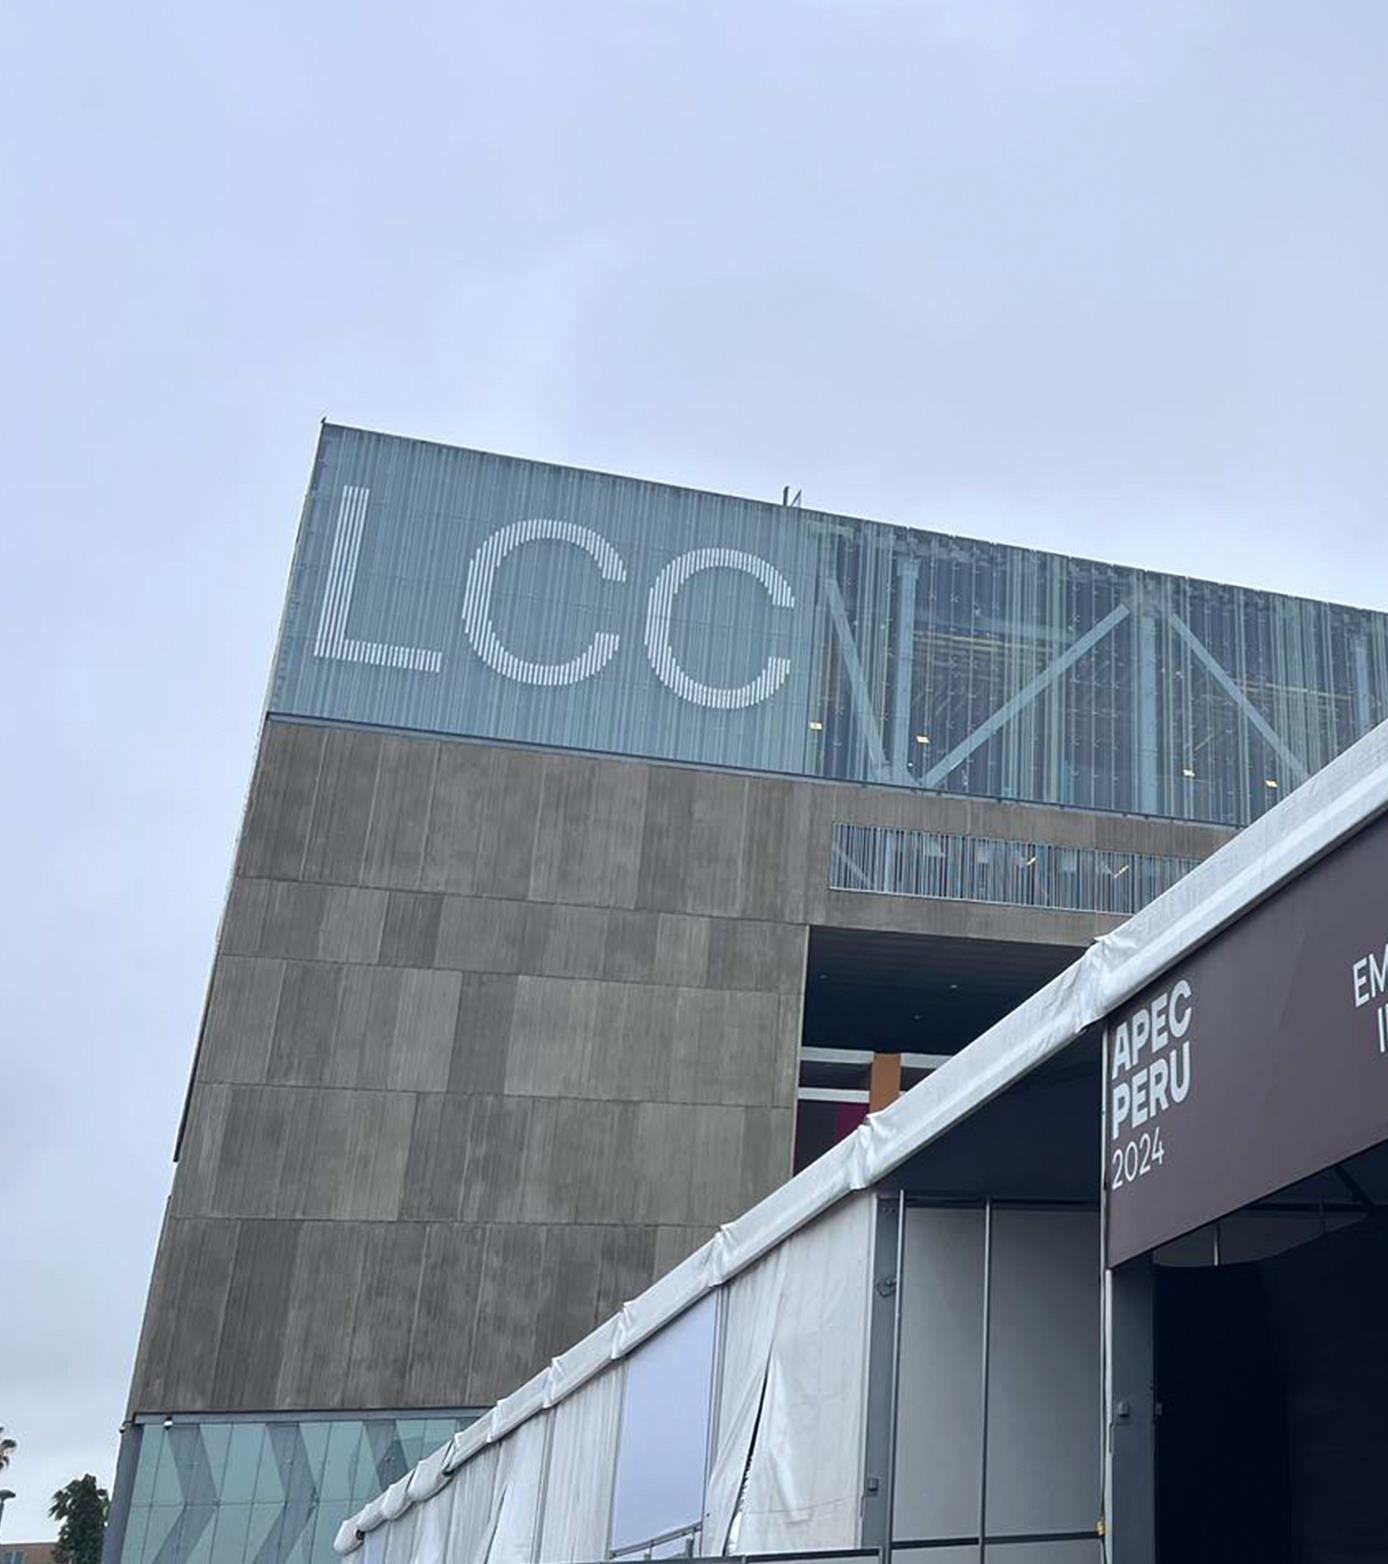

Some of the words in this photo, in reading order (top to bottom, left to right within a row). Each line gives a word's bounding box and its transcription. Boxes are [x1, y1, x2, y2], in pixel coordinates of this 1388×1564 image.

[313, 485, 795, 709] LCC
[1111, 979, 1193, 1080] APEC
[1112, 1041, 1192, 1140] PERU
[1111, 1126, 1165, 1191] 2024
